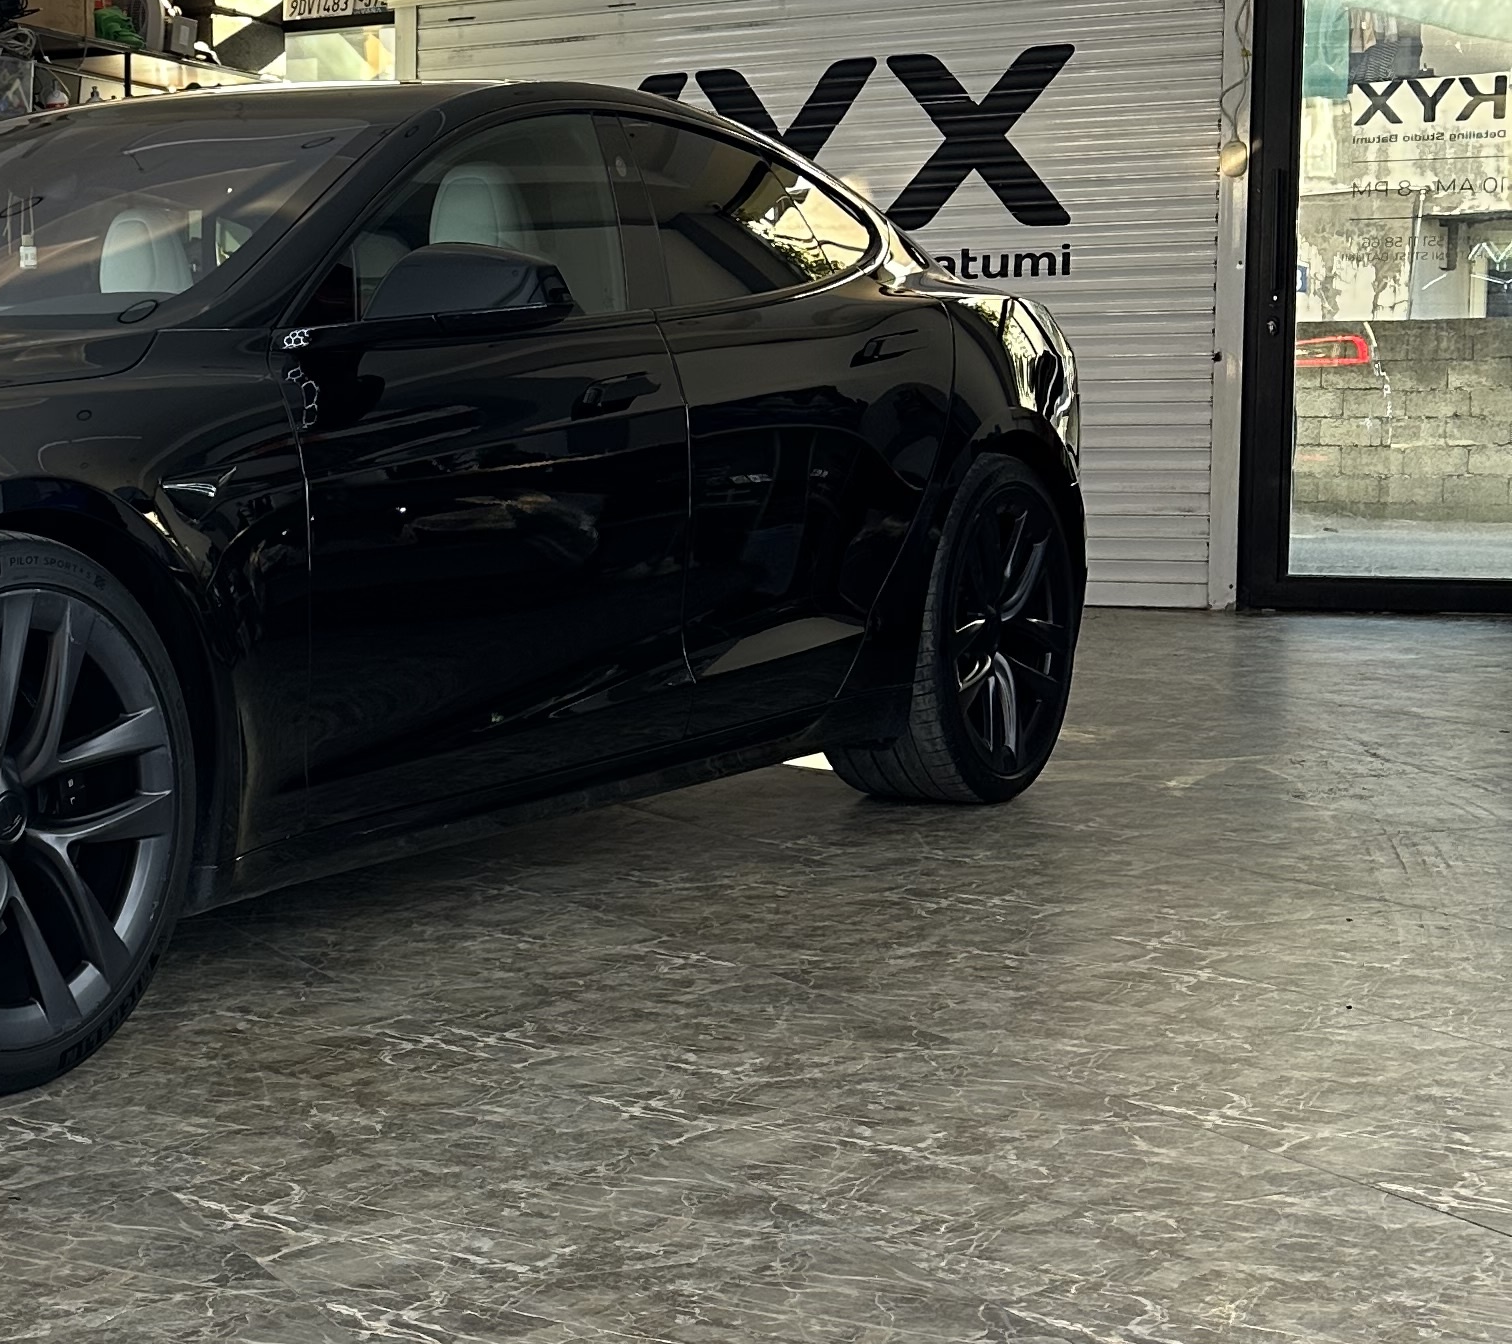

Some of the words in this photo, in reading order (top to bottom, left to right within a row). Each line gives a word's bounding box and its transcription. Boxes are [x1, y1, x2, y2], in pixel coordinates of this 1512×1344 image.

[638, 42, 1076, 230] YX
[934, 243, 1072, 278] atumi
[9, 555, 39, 567] PILOT
[43, 557, 77, 572] SPORT
